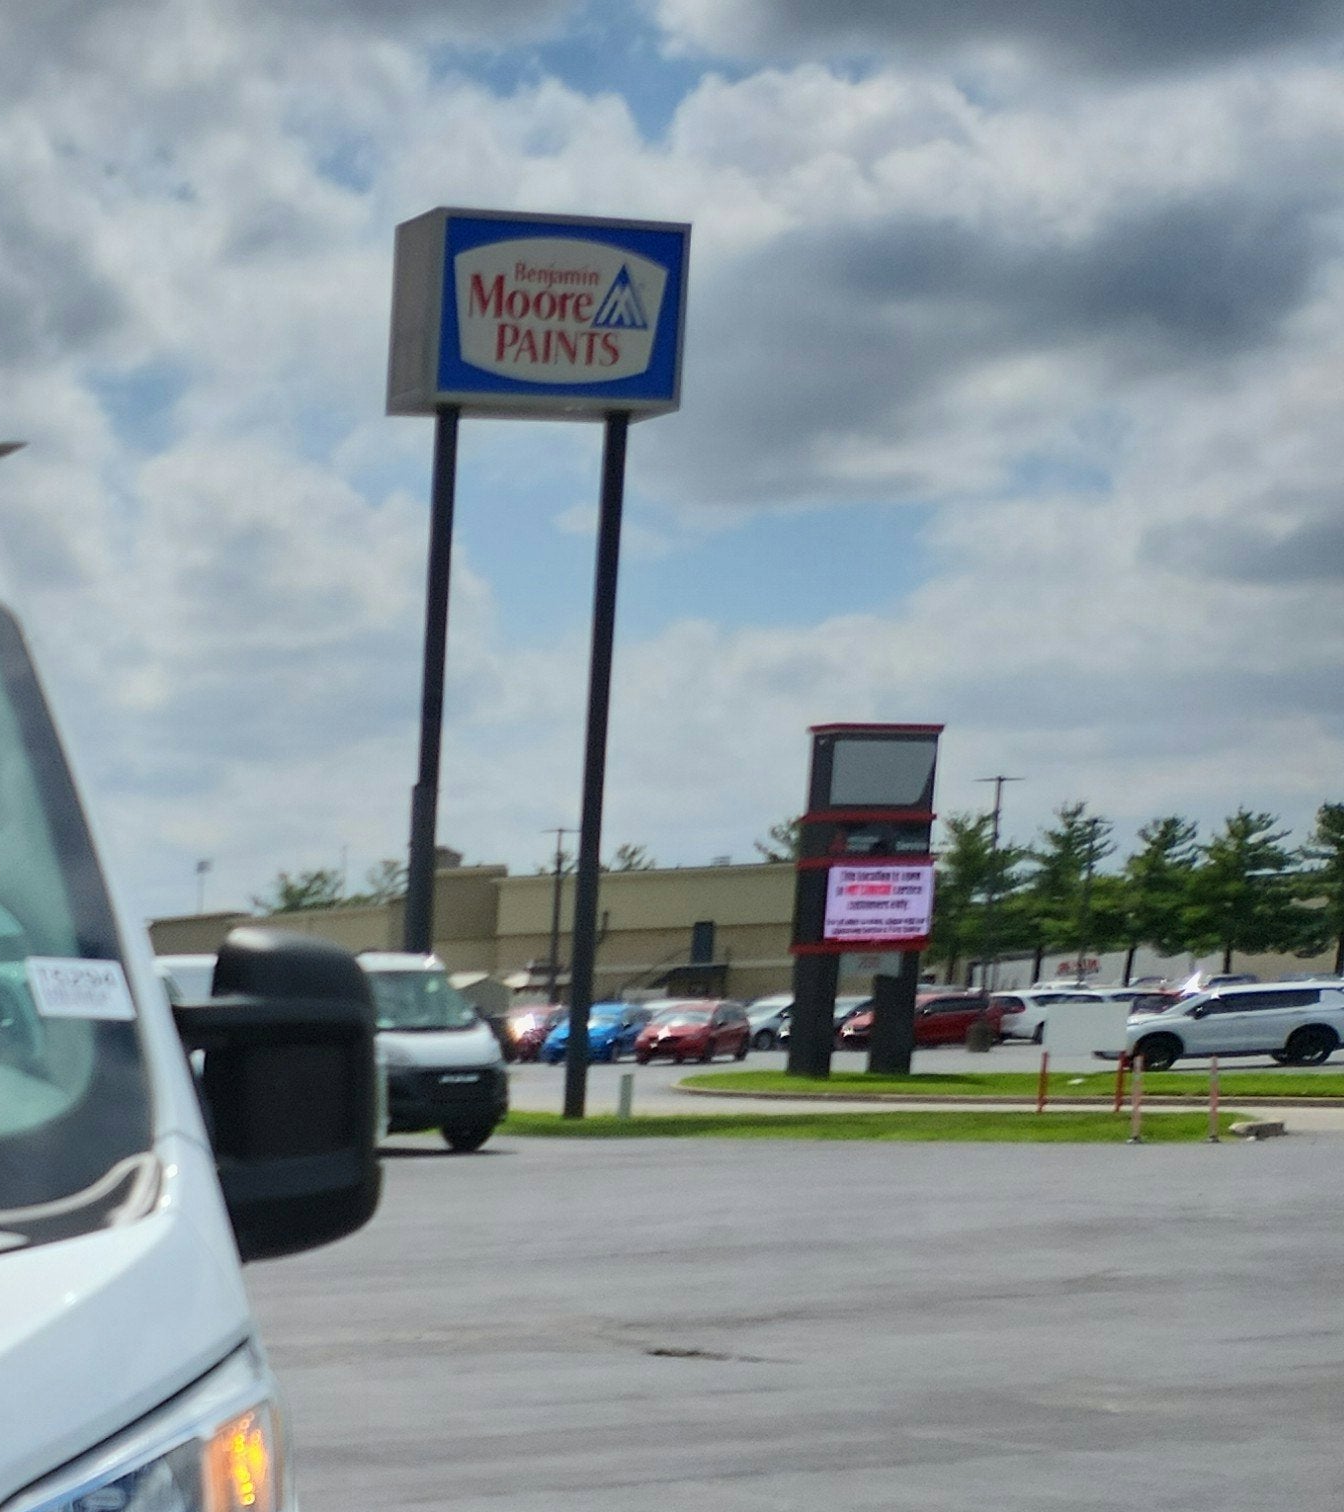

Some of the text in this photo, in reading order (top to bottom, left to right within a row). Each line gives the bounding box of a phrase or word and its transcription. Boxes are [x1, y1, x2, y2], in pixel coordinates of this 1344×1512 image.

[515, 261, 600, 287] Benjamin
[468, 273, 594, 323] Moore
[495, 324, 621, 366] PAINTS
